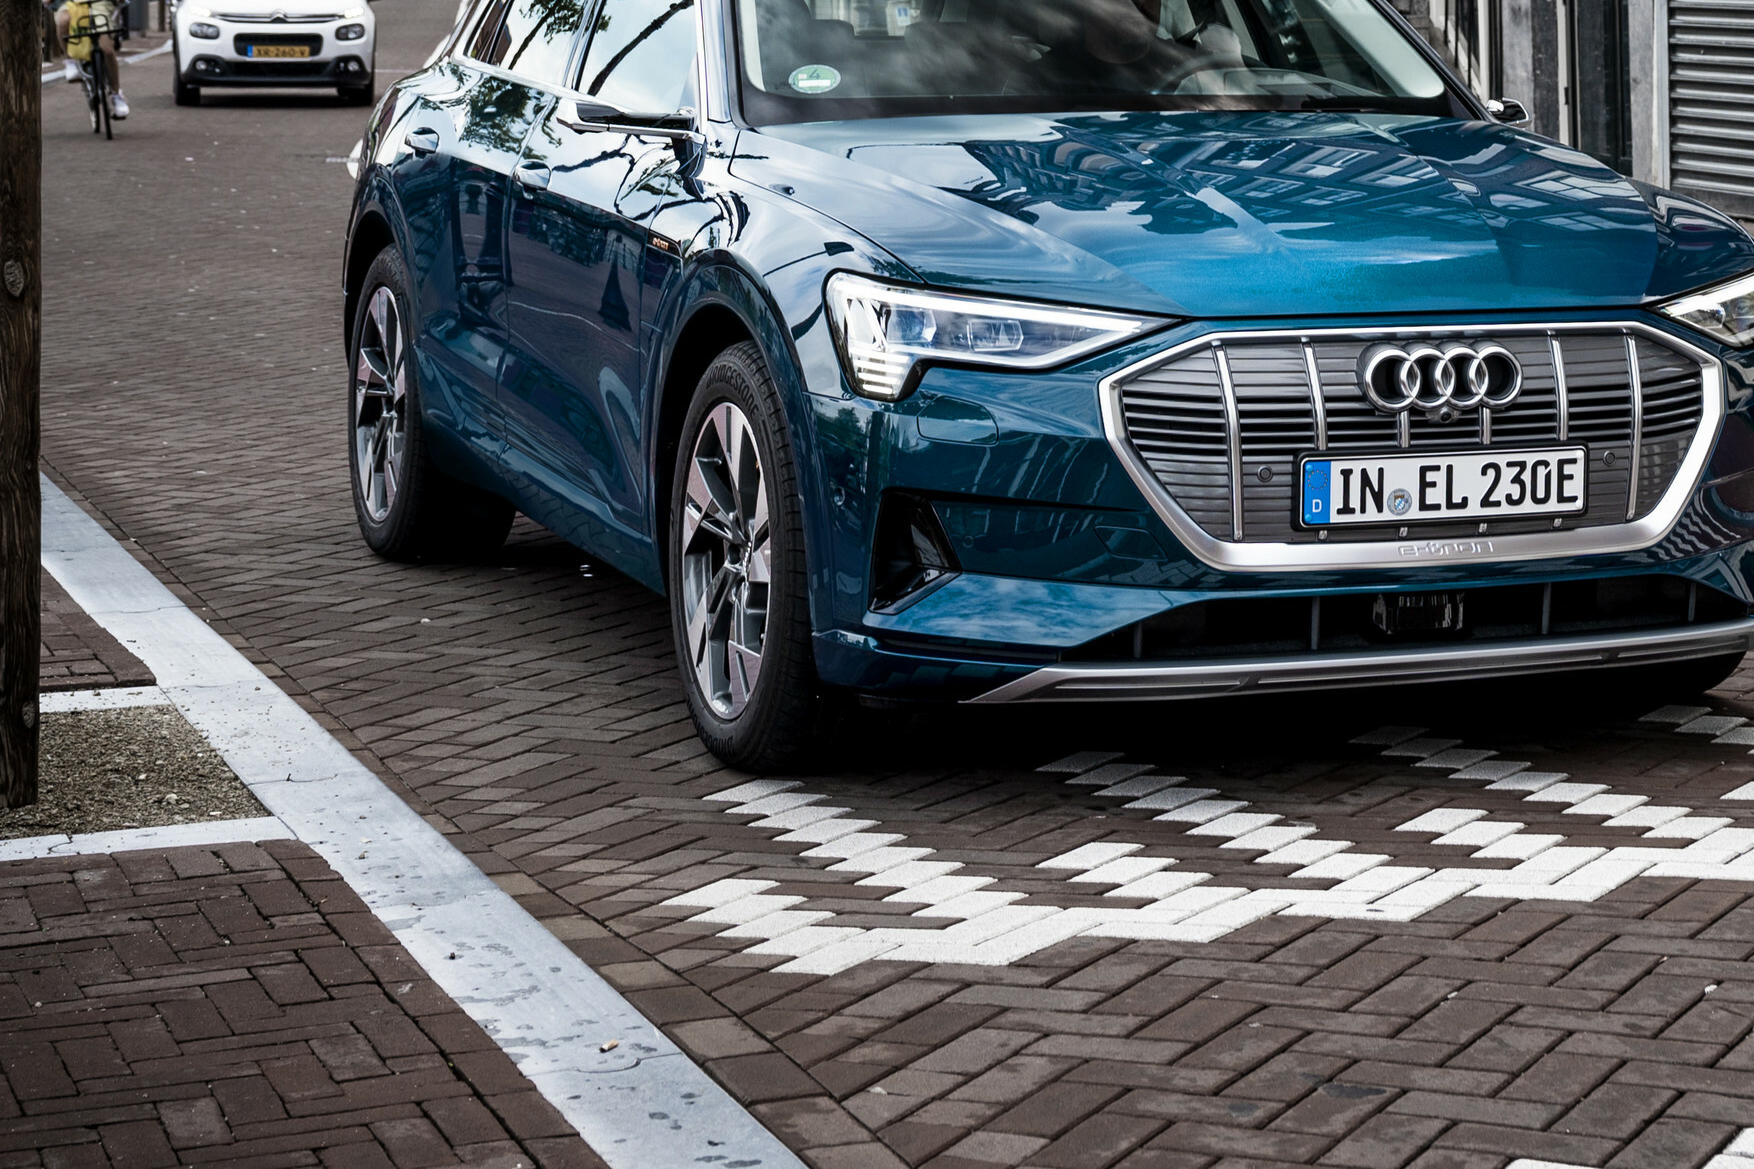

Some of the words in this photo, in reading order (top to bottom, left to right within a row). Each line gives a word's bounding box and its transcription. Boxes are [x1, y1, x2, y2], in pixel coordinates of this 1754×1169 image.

[1336, 466, 1385, 516] IN
[1418, 464, 1469, 512] EL
[1479, 458, 1579, 509] 230E
[1311, 499, 1323, 514] D
